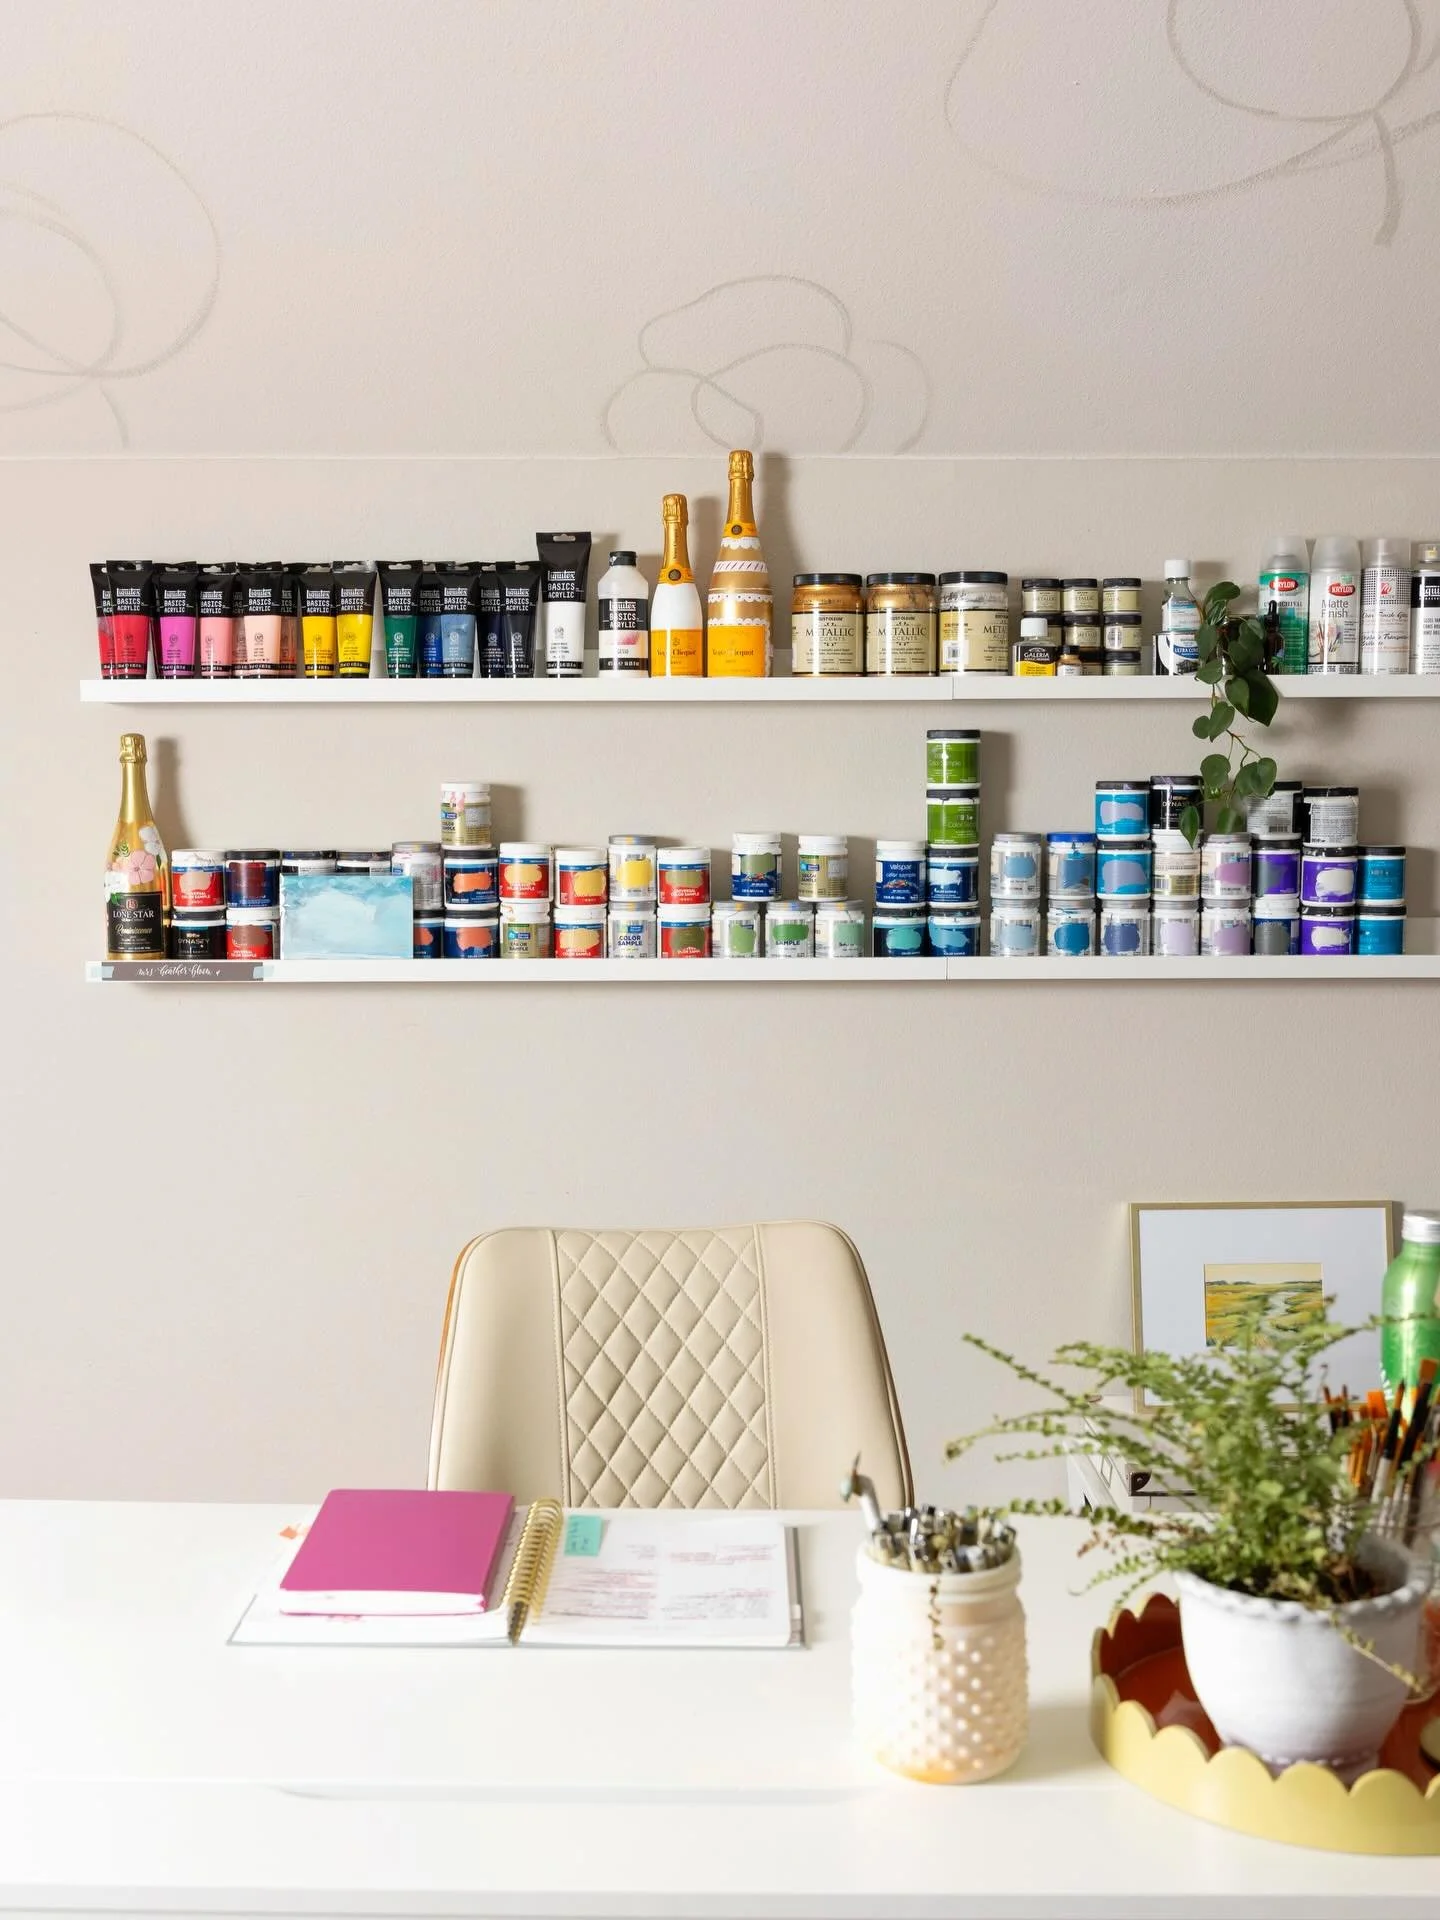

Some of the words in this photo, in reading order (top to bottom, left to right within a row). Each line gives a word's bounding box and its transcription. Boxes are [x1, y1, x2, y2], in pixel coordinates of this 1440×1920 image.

[548, 570, 575, 581] Liquitex
[1321, 600, 1348, 608] Matte
[1321, 609, 1348, 618] Fnish
[806, 628, 855, 636] MTALLIC
[878, 628, 926, 636] MTALLIC
